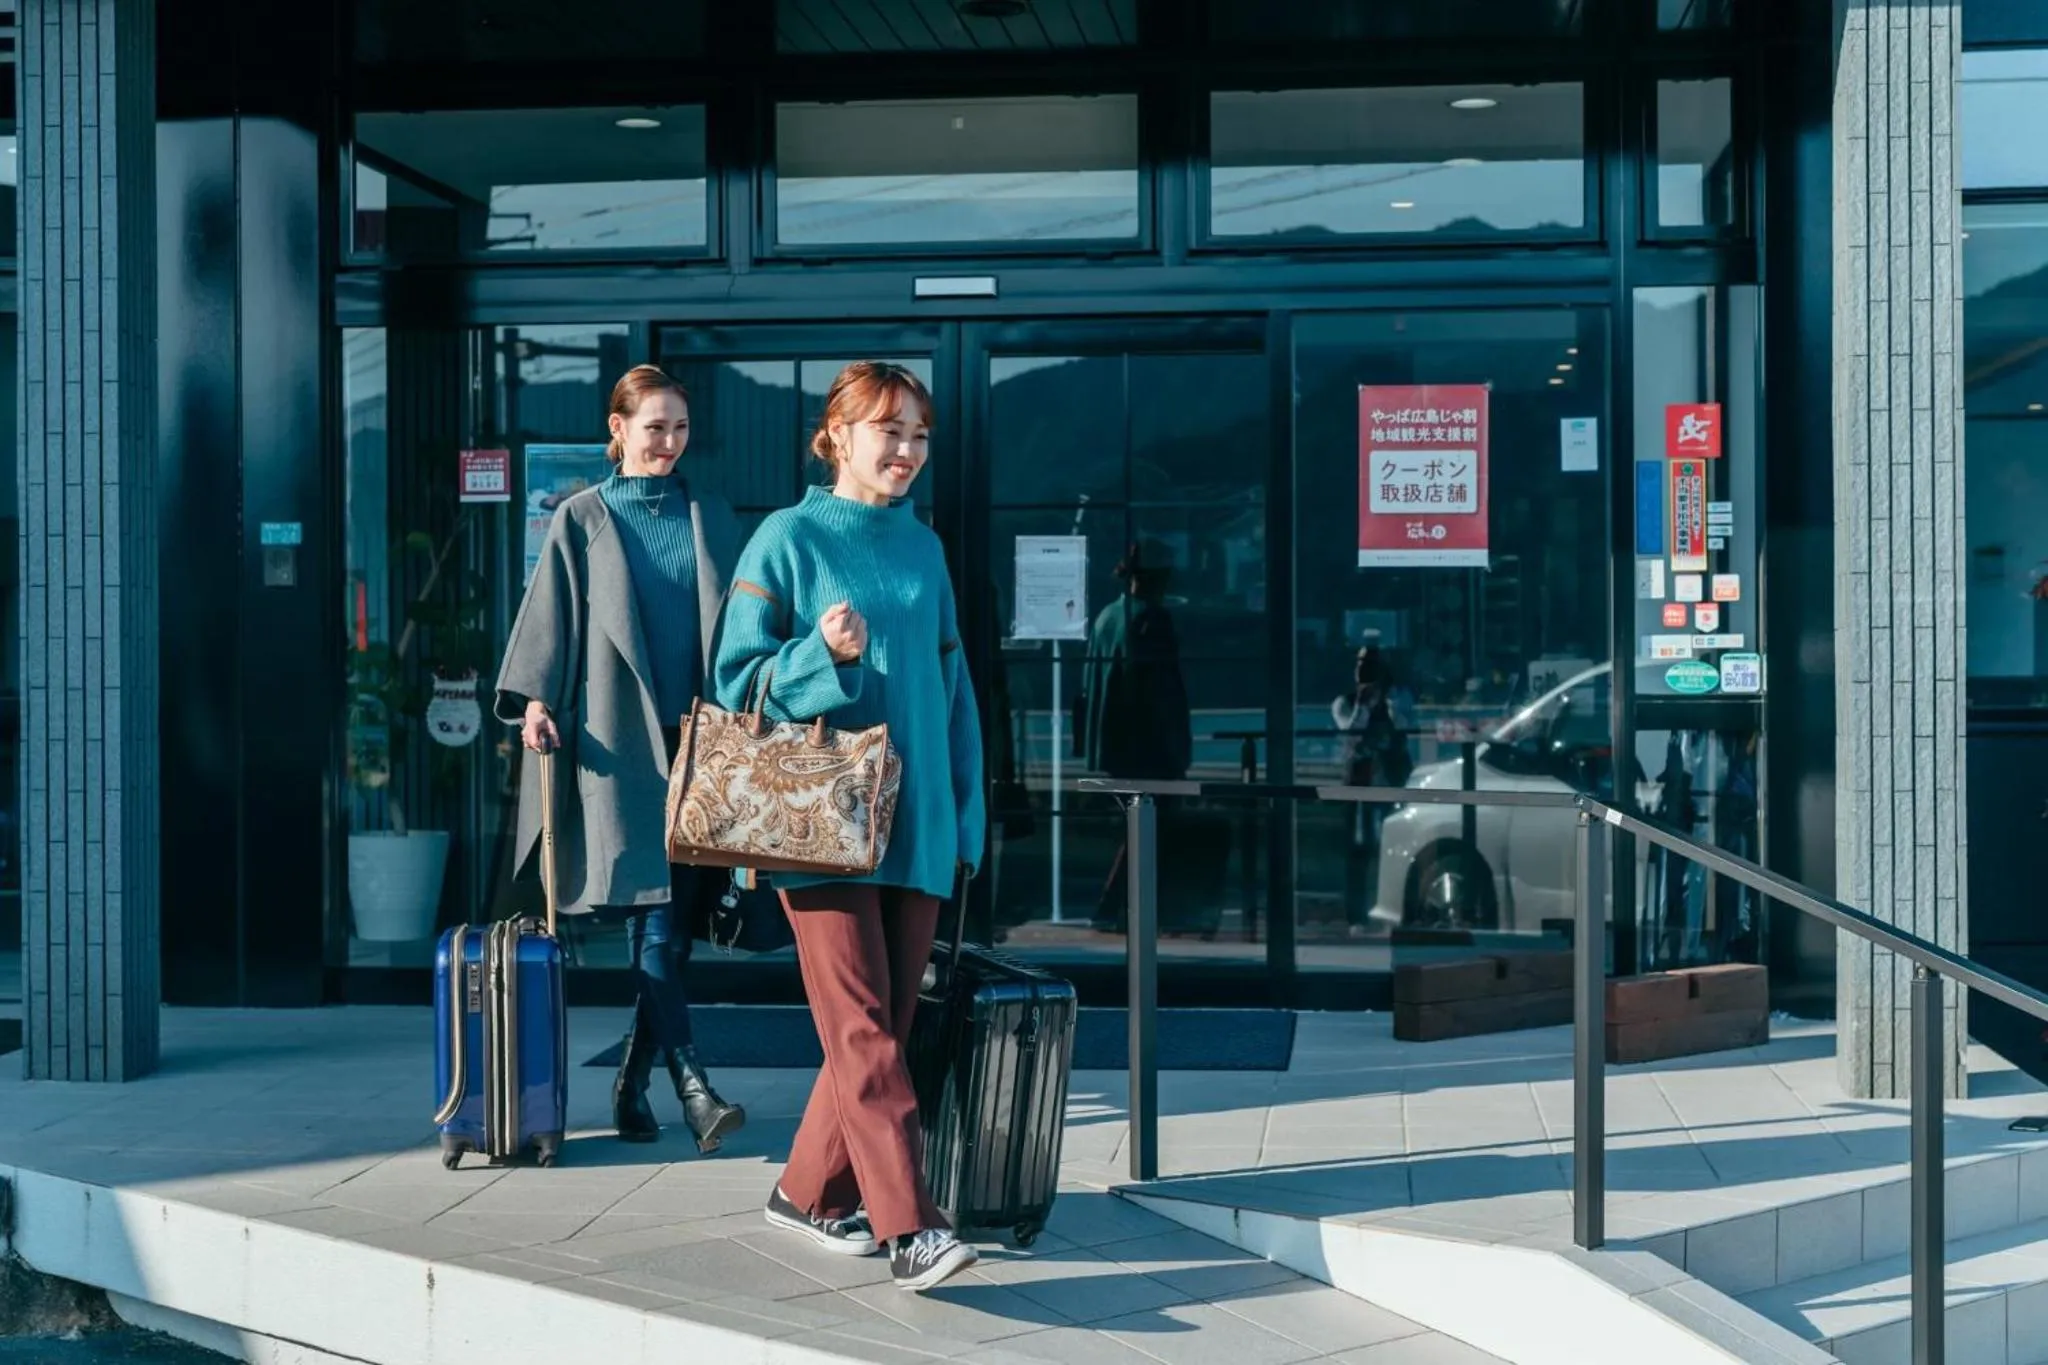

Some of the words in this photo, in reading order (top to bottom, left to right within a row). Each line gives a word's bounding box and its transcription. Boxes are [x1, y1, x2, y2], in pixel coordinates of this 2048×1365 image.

[1370, 408, 1477, 424] やっぱ広島じゃ割
[1371, 427, 1477, 442] 地域観光支援割
[1381, 459, 1467, 480] クーポン
[1381, 483, 1467, 503] 取扱店舗
